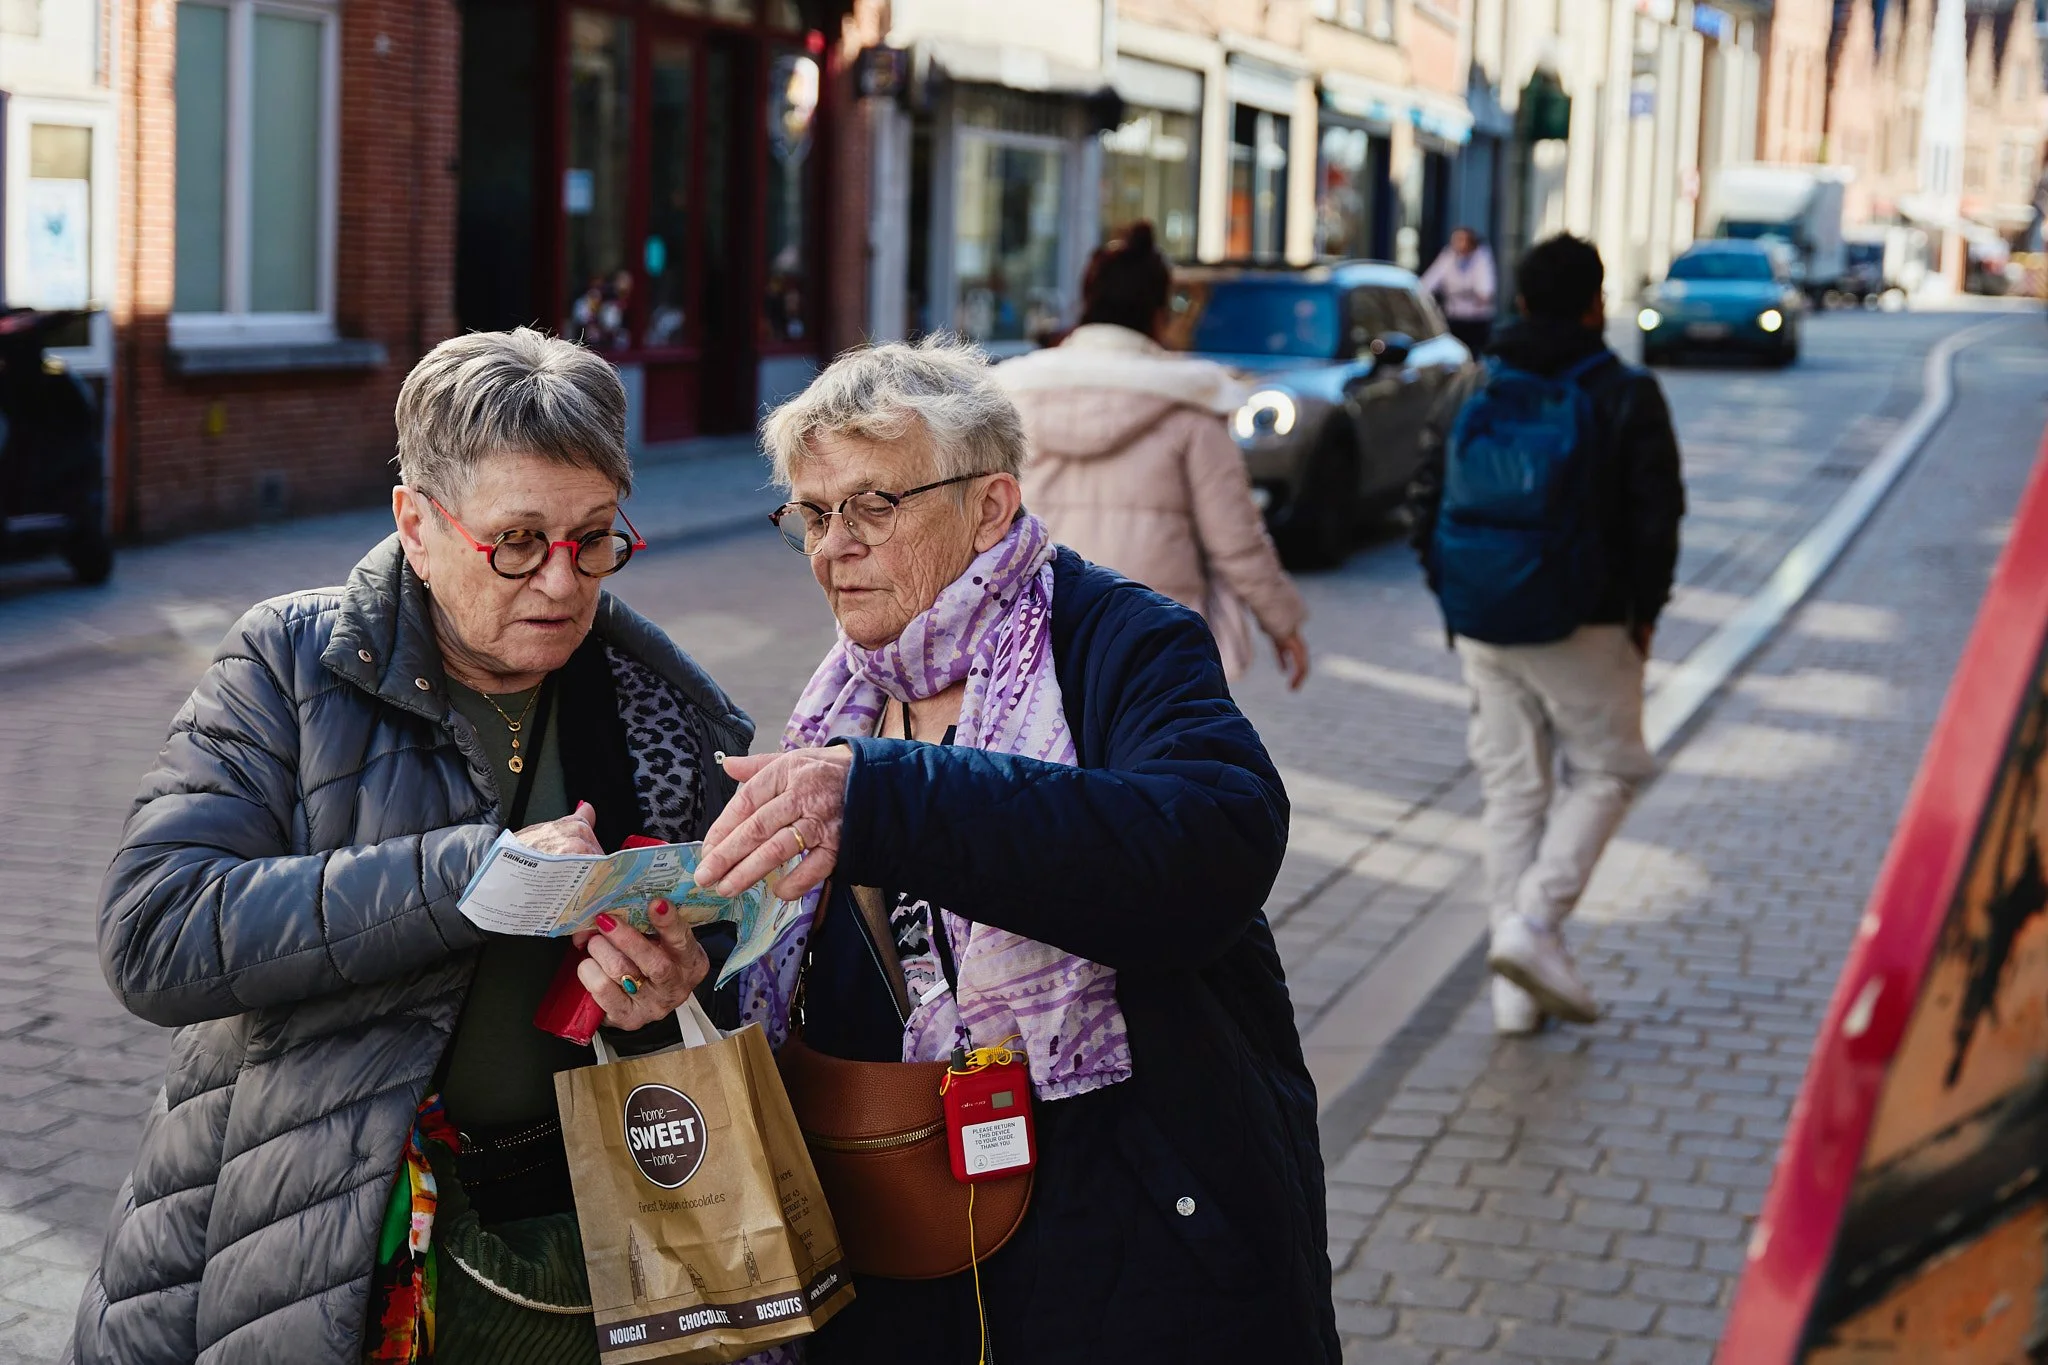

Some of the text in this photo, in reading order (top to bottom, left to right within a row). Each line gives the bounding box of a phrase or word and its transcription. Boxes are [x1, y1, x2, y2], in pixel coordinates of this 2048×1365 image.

[640, 1107, 666, 1122] home
[629, 1117, 695, 1151] SWEET
[972, 1122, 1016, 1134] PLEASE RETURN
[992, 1128, 1011, 1137] DEVICE
[980, 1142, 998, 1150] THANK
[983, 1136, 997, 1144] YOUR
[651, 1152, 677, 1166] home
[638, 1201, 658, 1213] finest
[681, 1193, 726, 1210] chocolates
[609, 1296, 803, 1346] NOUGAT CHOCOLATE BISCUITS
